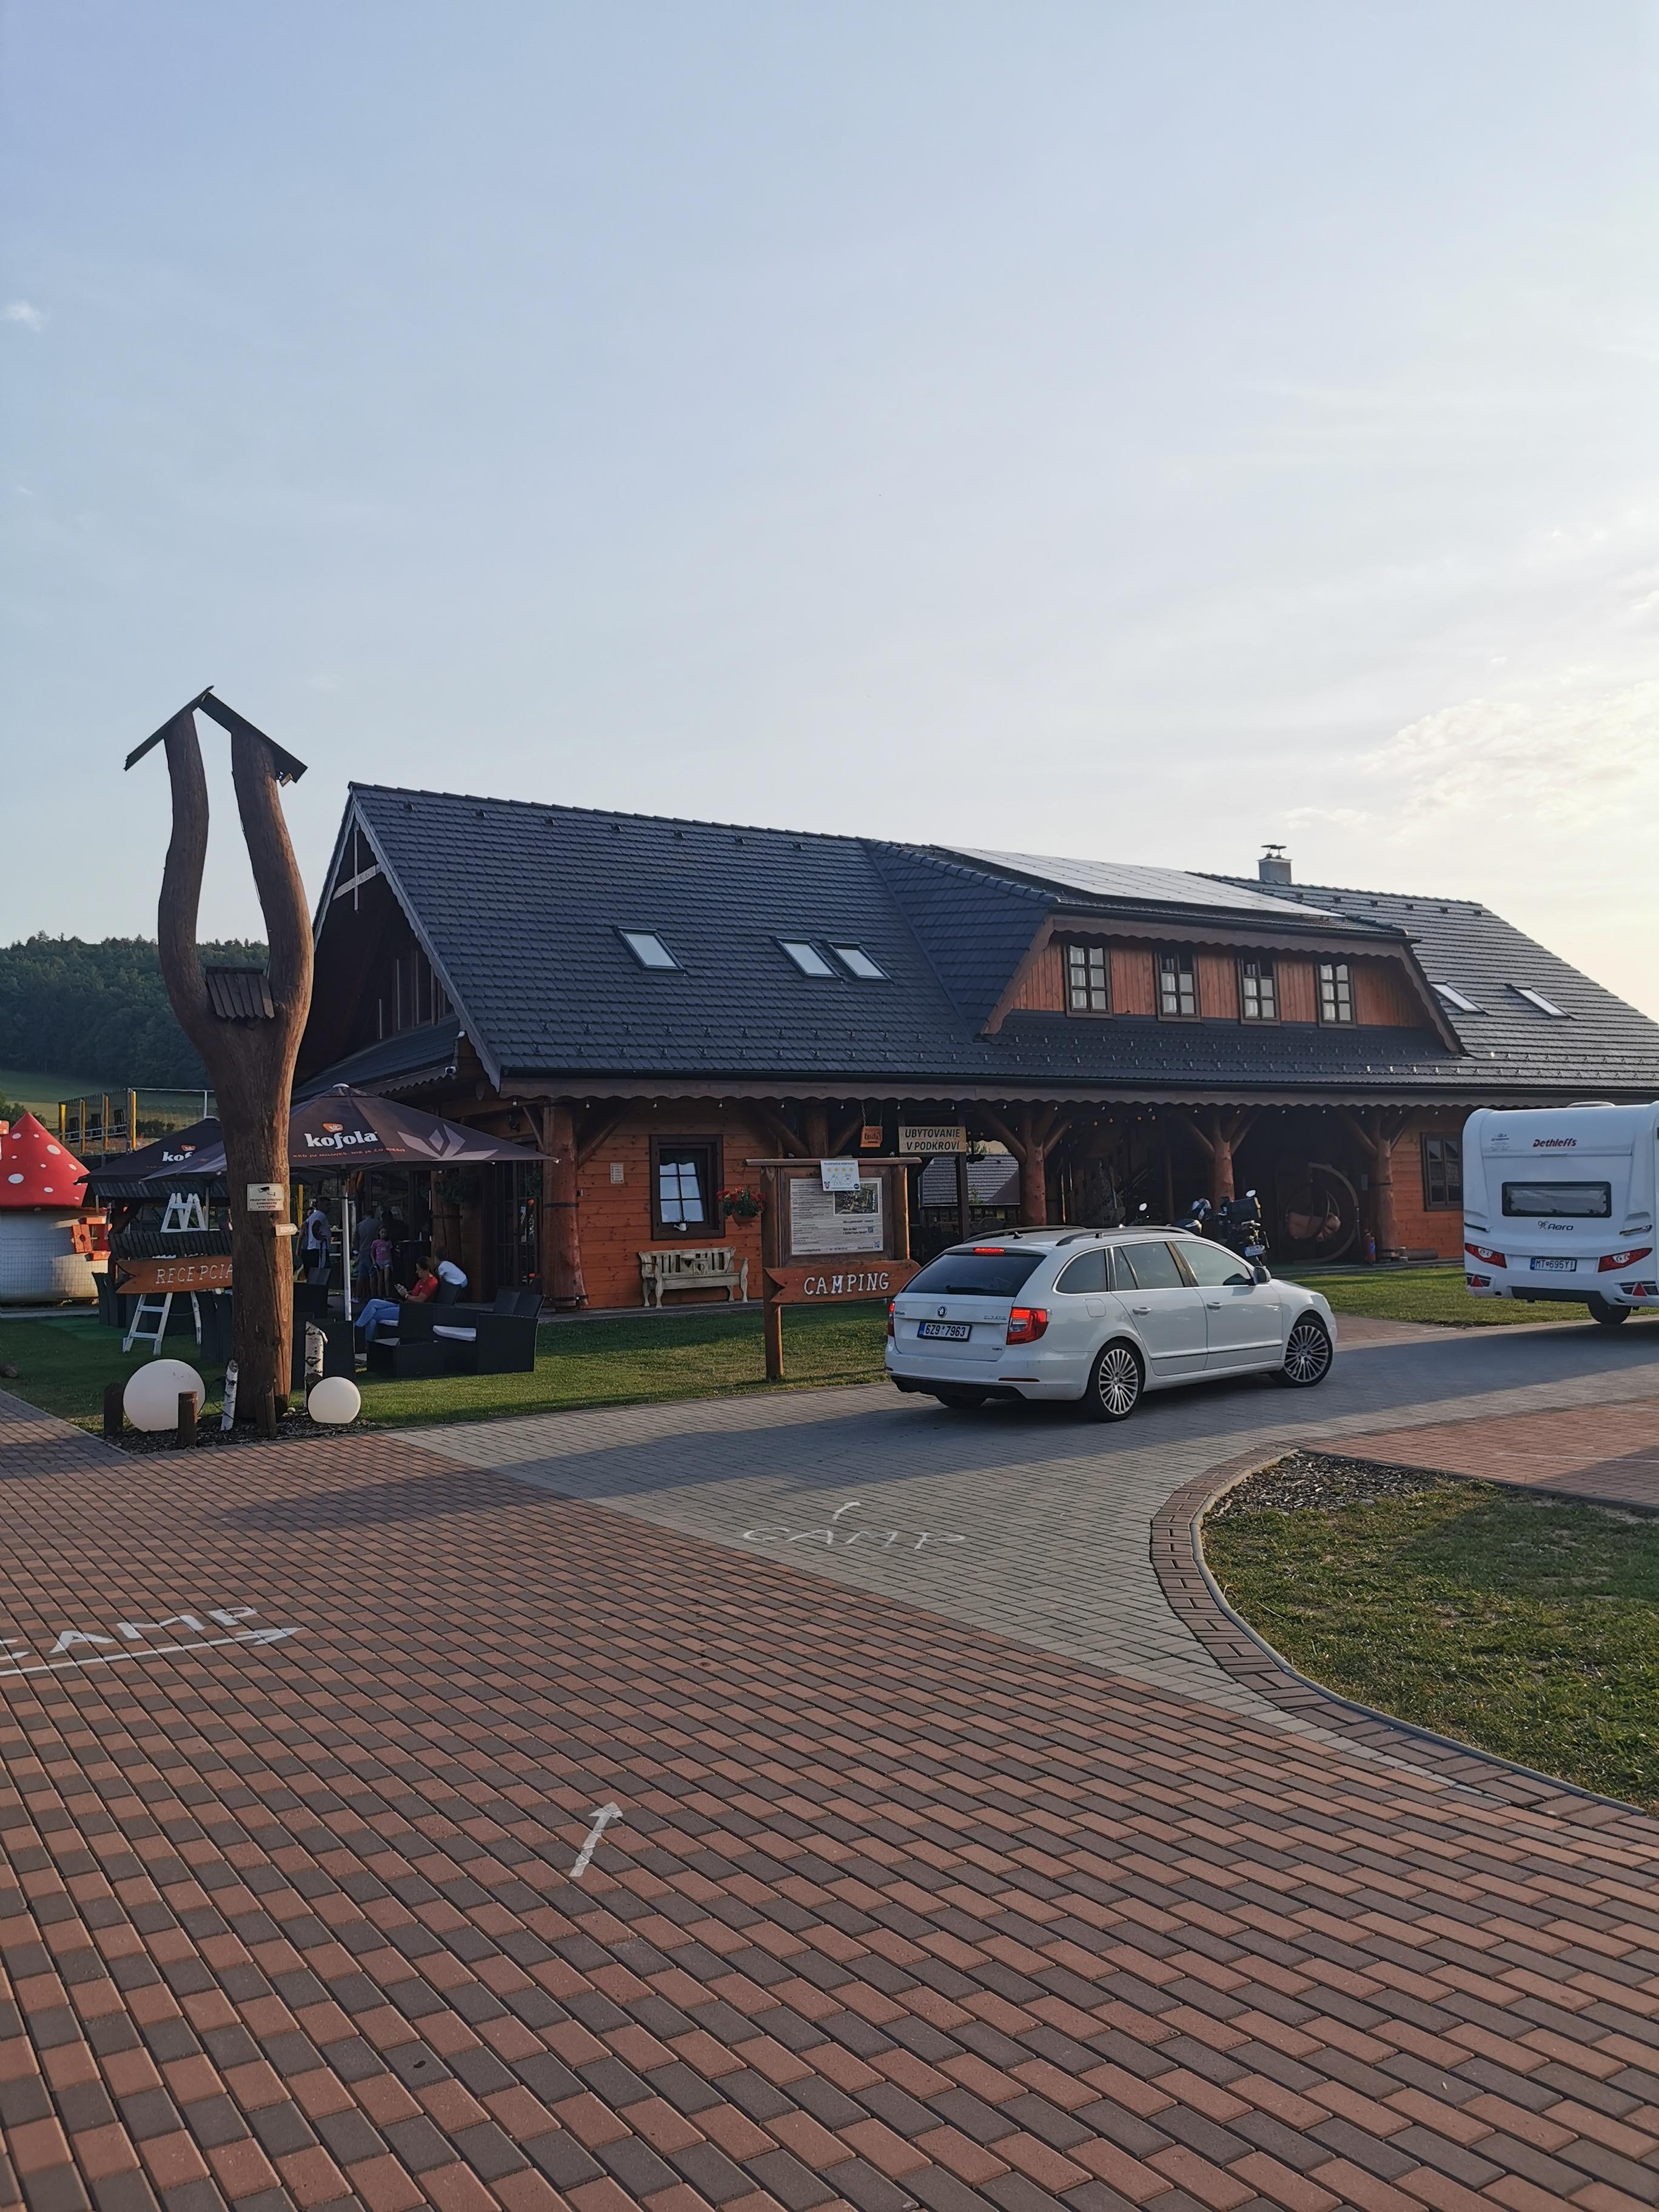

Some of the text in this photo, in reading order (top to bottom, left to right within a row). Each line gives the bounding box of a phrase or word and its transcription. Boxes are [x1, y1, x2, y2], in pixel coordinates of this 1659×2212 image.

[905, 1128, 960, 1138] UBYTOVANIE
[304, 1130, 378, 1150] kofola
[906, 1142, 913, 1150] V
[1533, 1138, 1577, 1148] Dethleffs
[161, 1151, 193, 1162] kof
[804, 1272, 890, 1295] CAMPING
[925, 1324, 966, 1337] 6Z9 7963
[742, 1527, 967, 1550] CAMP
